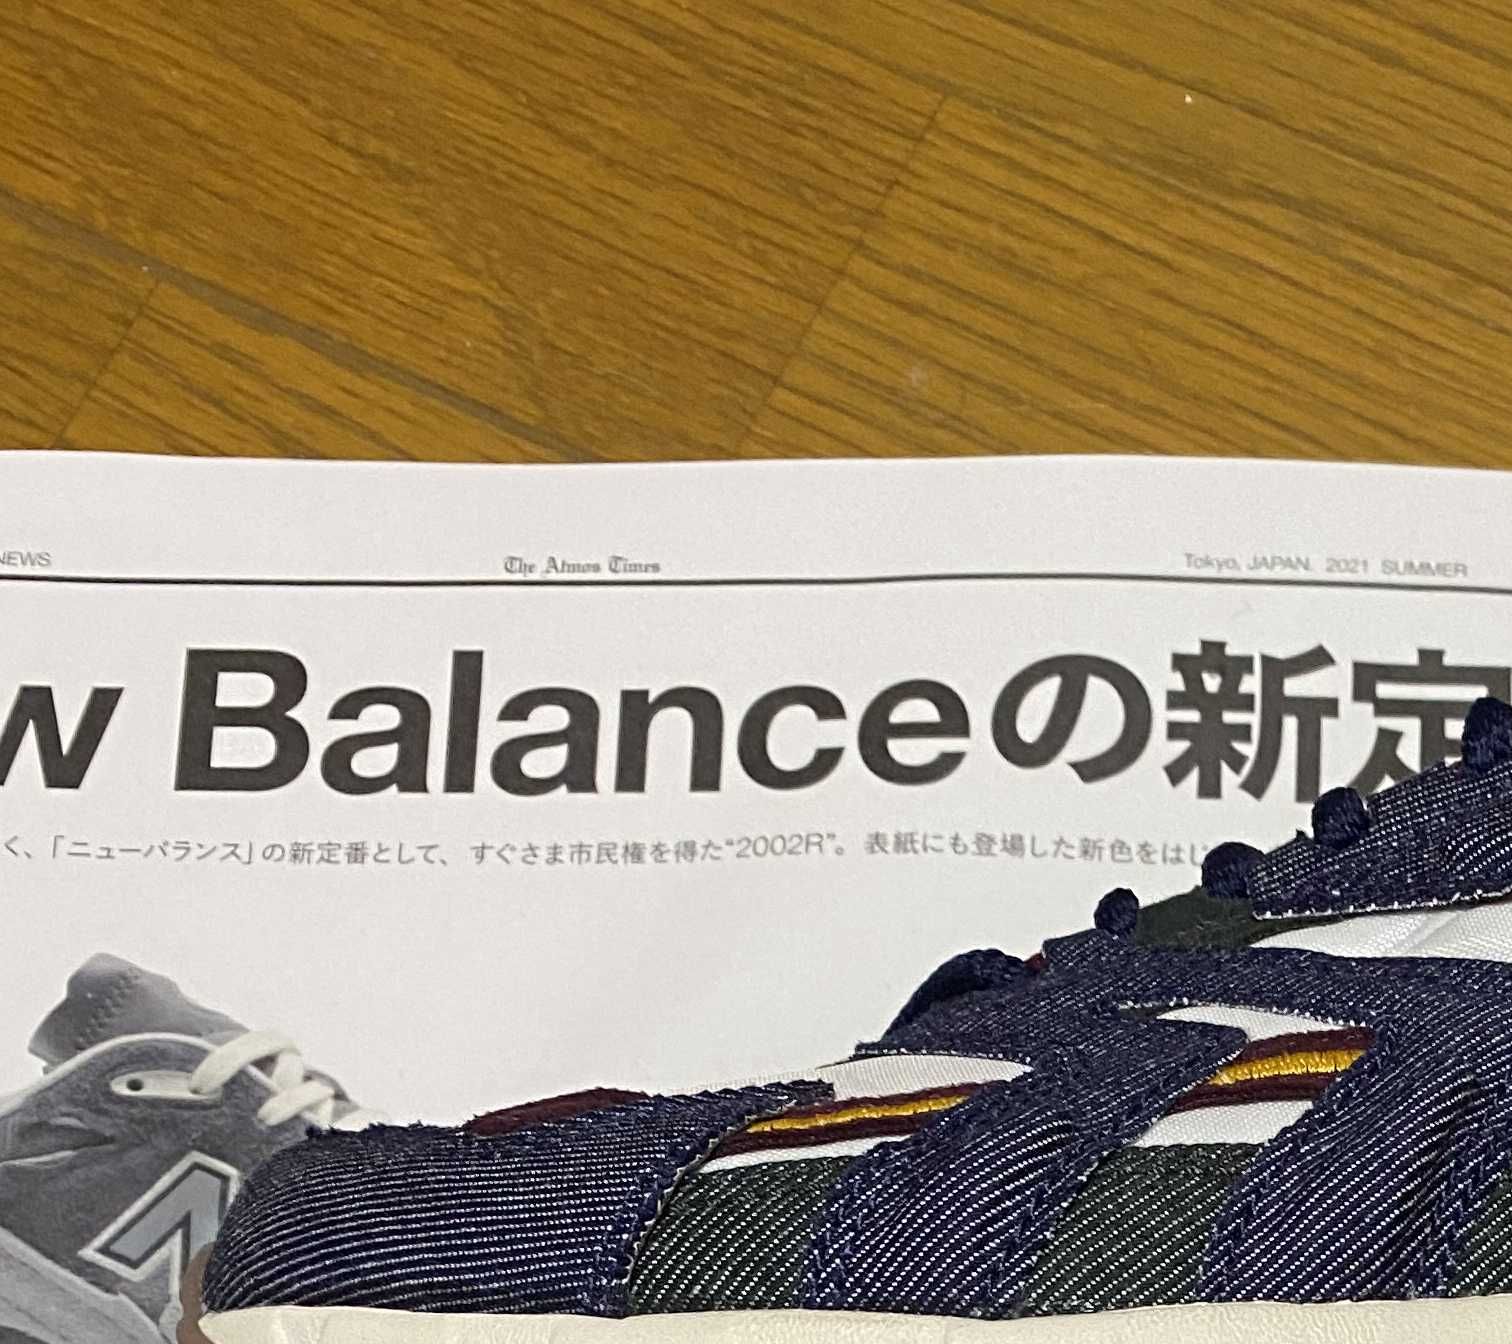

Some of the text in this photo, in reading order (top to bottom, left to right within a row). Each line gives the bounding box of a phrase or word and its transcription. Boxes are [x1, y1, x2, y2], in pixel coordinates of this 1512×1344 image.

[504, 555, 662, 577] The Atmos Times
[1325, 557, 1369, 575] 2021
[1381, 559, 1469, 577] SUMMER
